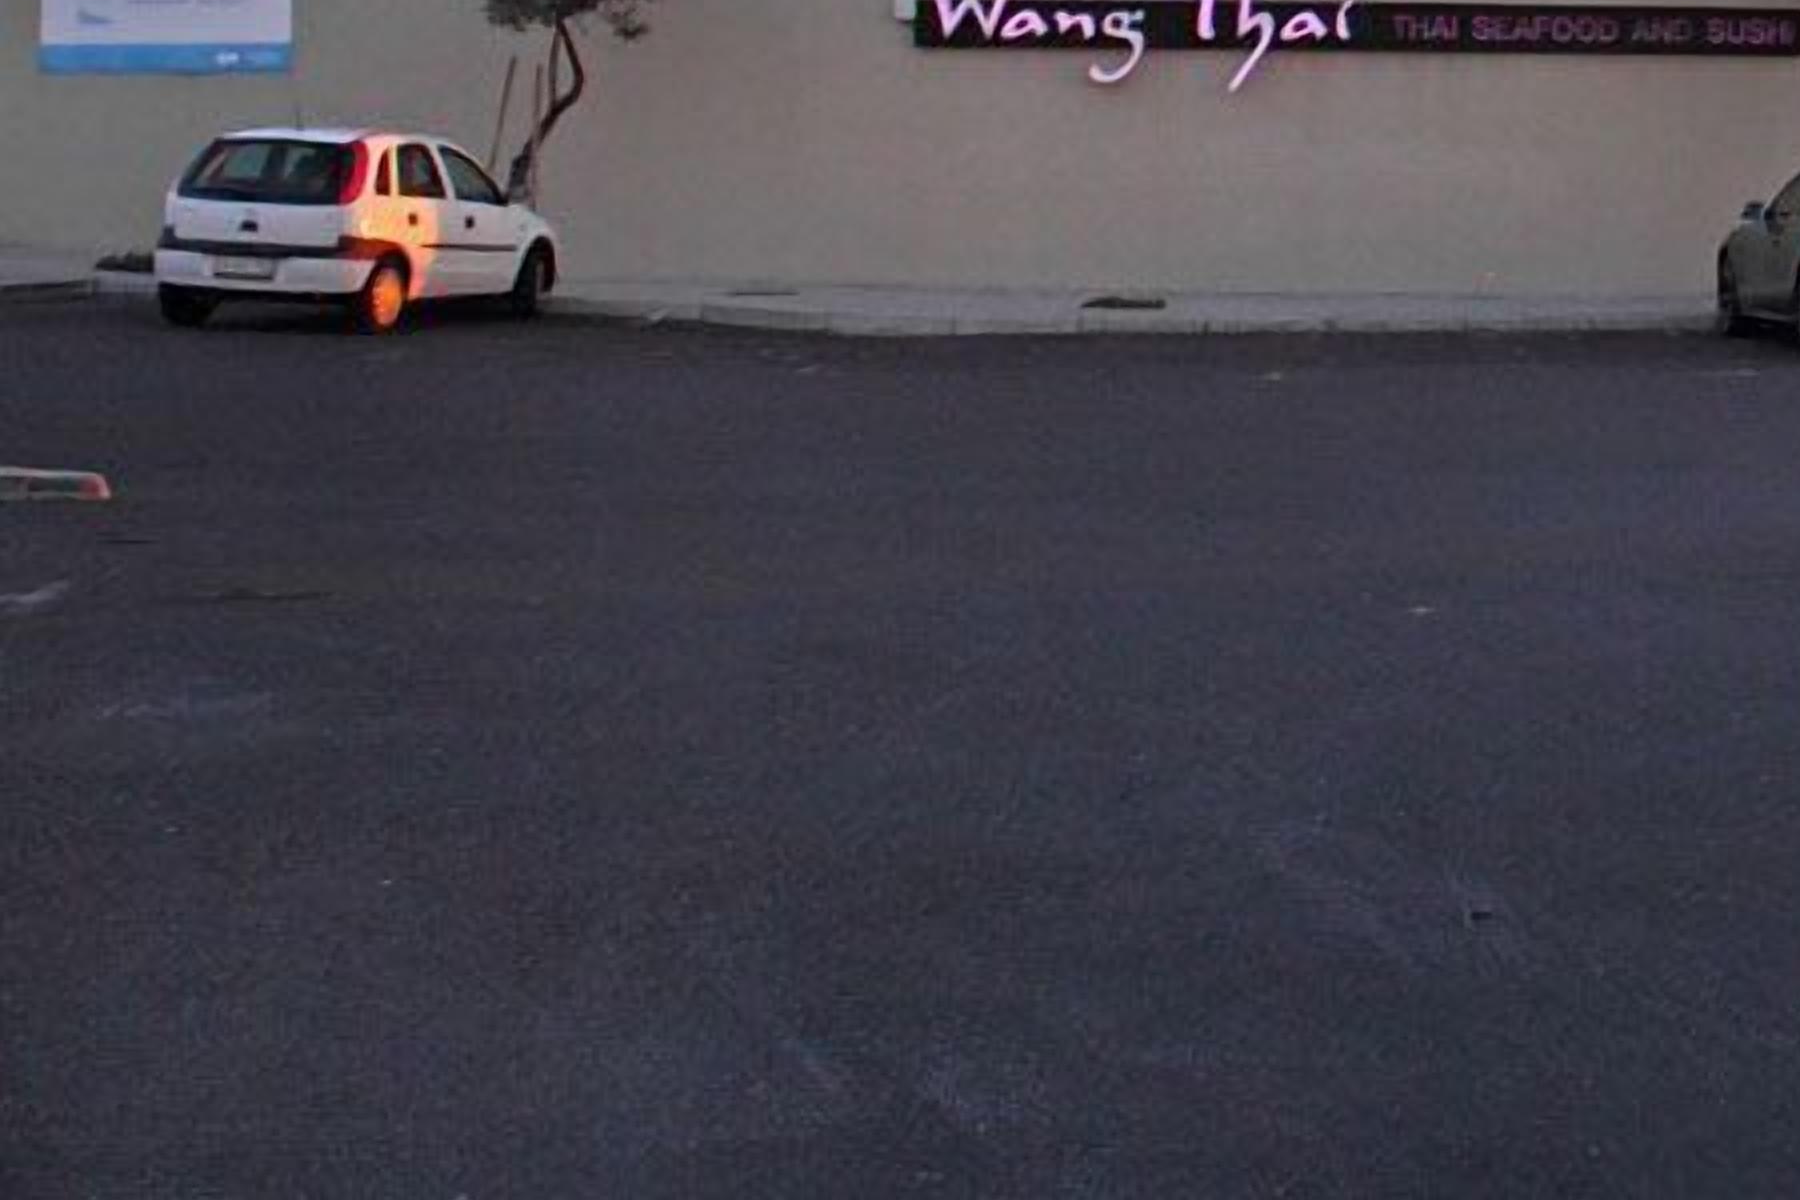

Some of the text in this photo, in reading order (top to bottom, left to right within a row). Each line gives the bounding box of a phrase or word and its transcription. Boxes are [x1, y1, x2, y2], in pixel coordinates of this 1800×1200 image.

[1392, 14, 1797, 46] THAI SEAFOOD AND SUSHI
